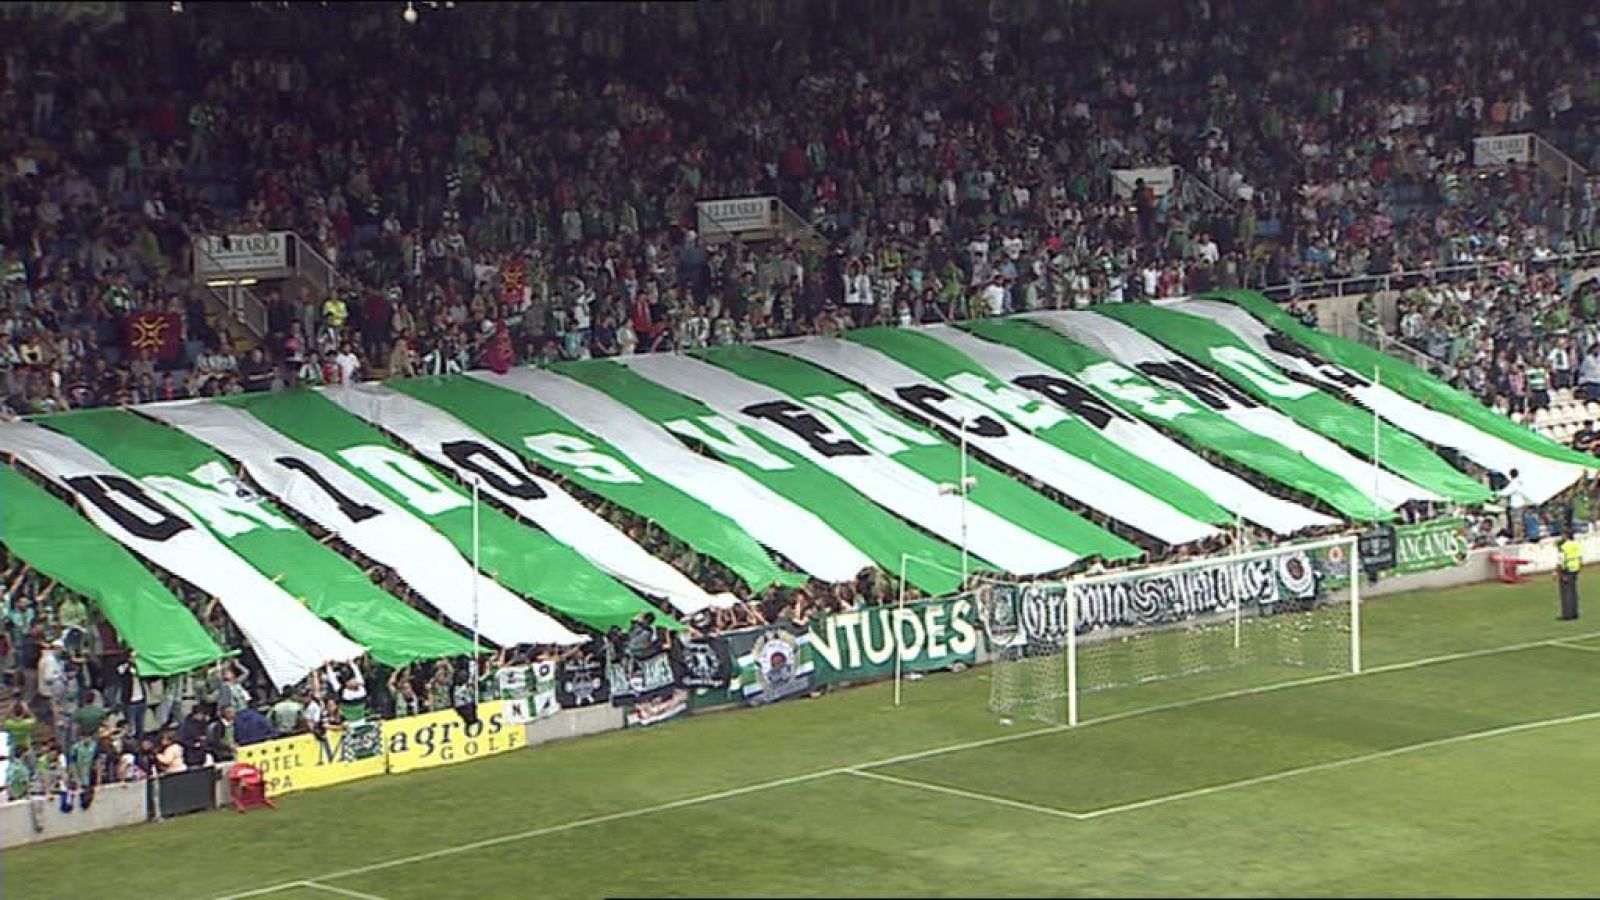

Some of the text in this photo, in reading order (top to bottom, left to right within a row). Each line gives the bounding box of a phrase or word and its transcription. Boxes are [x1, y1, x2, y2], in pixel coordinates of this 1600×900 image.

[61, 433, 643, 541] UNIDOS
[441, 731, 519, 760] GOLF
[253, 753, 303, 774] OTEL
